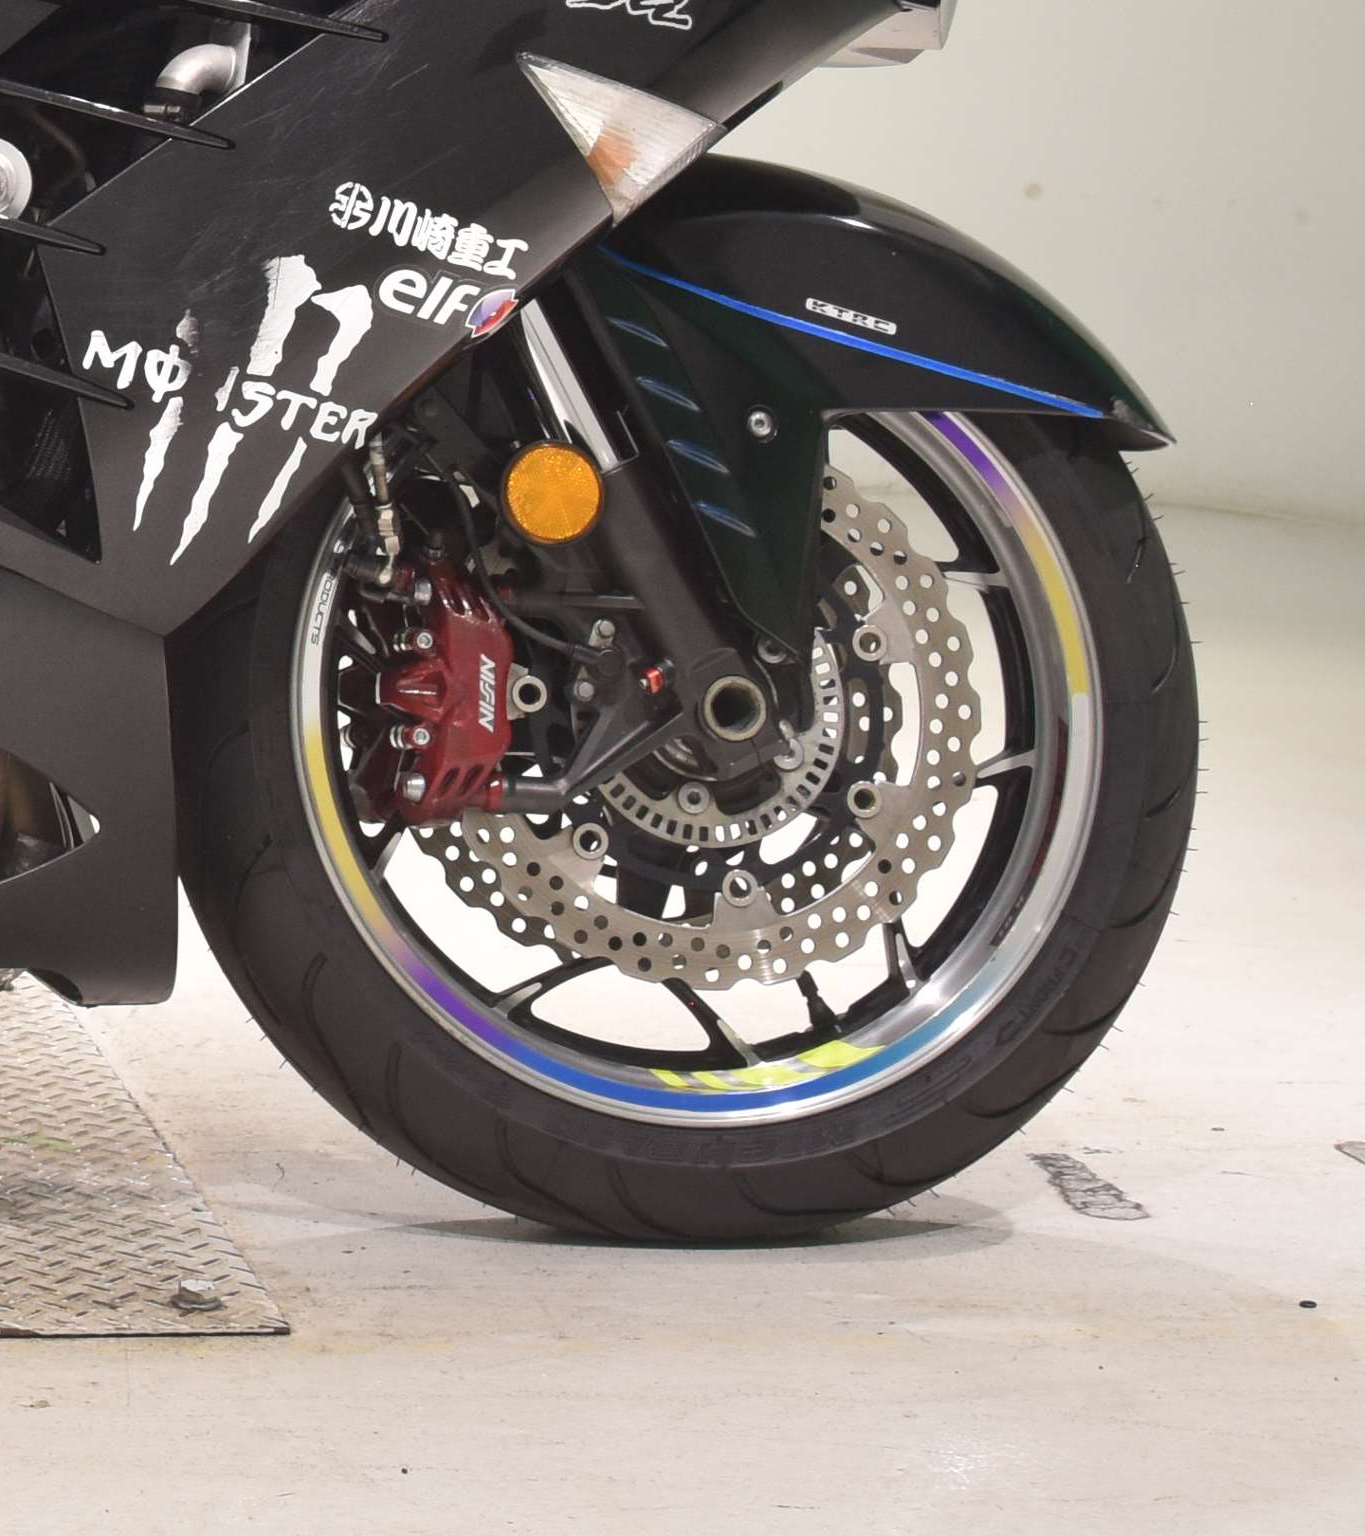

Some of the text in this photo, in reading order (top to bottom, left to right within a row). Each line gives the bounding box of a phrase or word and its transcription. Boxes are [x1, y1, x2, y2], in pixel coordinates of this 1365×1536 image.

[369, 196, 529, 280] 川崎重工
[378, 269, 481, 325] elf
[811, 300, 891, 333] KTRC
[477, 653, 497, 734] NISSIN
